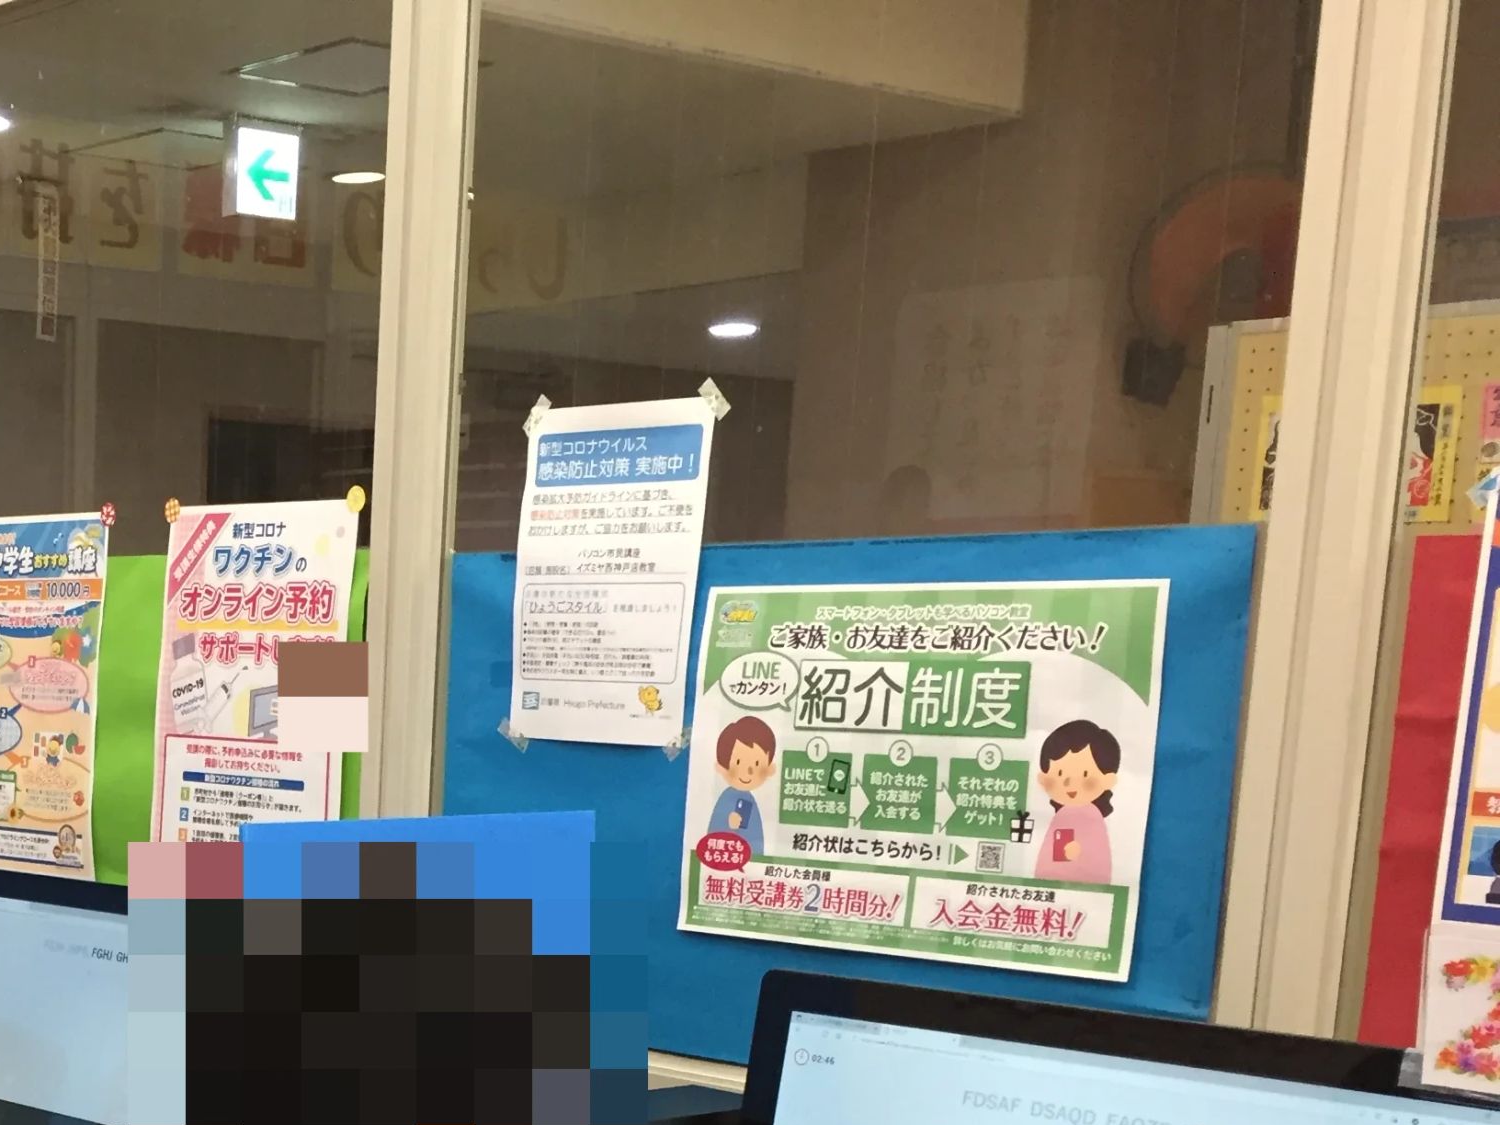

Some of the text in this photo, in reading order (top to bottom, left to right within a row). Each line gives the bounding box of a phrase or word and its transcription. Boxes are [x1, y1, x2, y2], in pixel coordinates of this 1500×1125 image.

[539, 436, 647, 457] 新型コロナウイルス
[538, 453, 695, 480] 感染防止対策 実施中！
[232, 522, 287, 539] 新型コロナ
[213, 545, 308, 577] ワクチンの
[180, 581, 336, 624] オンライン予約
[769, 622, 1107, 651] ご家族・お友達をご紹介ください！
[742, 661, 781, 680] LINE
[172, 678, 204, 699] COVID-19
[729, 682, 787, 697] でカンタン！
[799, 665, 1022, 730] 紹介制度
[784, 768, 825, 782] LINEで
[870, 772, 929, 788] 紹介された
[784, 782, 827, 797] お友達に
[958, 776, 1020, 792] それぞれの
[875, 788, 922, 804] お友達が
[956, 793, 1018, 810] 紹介特典を
[782, 799, 848, 815] 紹介状を送る
[963, 810, 1003, 826] ゲット！
[707, 838, 744, 851] 何度でも
[792, 832, 941, 861] 紹介状はこちらから！
[703, 850, 744, 864] もらえる！
[764, 865, 832, 882] 紹介した会員様
[704, 874, 901, 921] 無料受講券2時間分！
[966, 883, 1056, 904] 紹介されたお友達
[929, 898, 1084, 938] 入会金無料！
[811, 1053, 836, 1066] 02:46
[962, 1090, 1022, 1114] FDSAF
